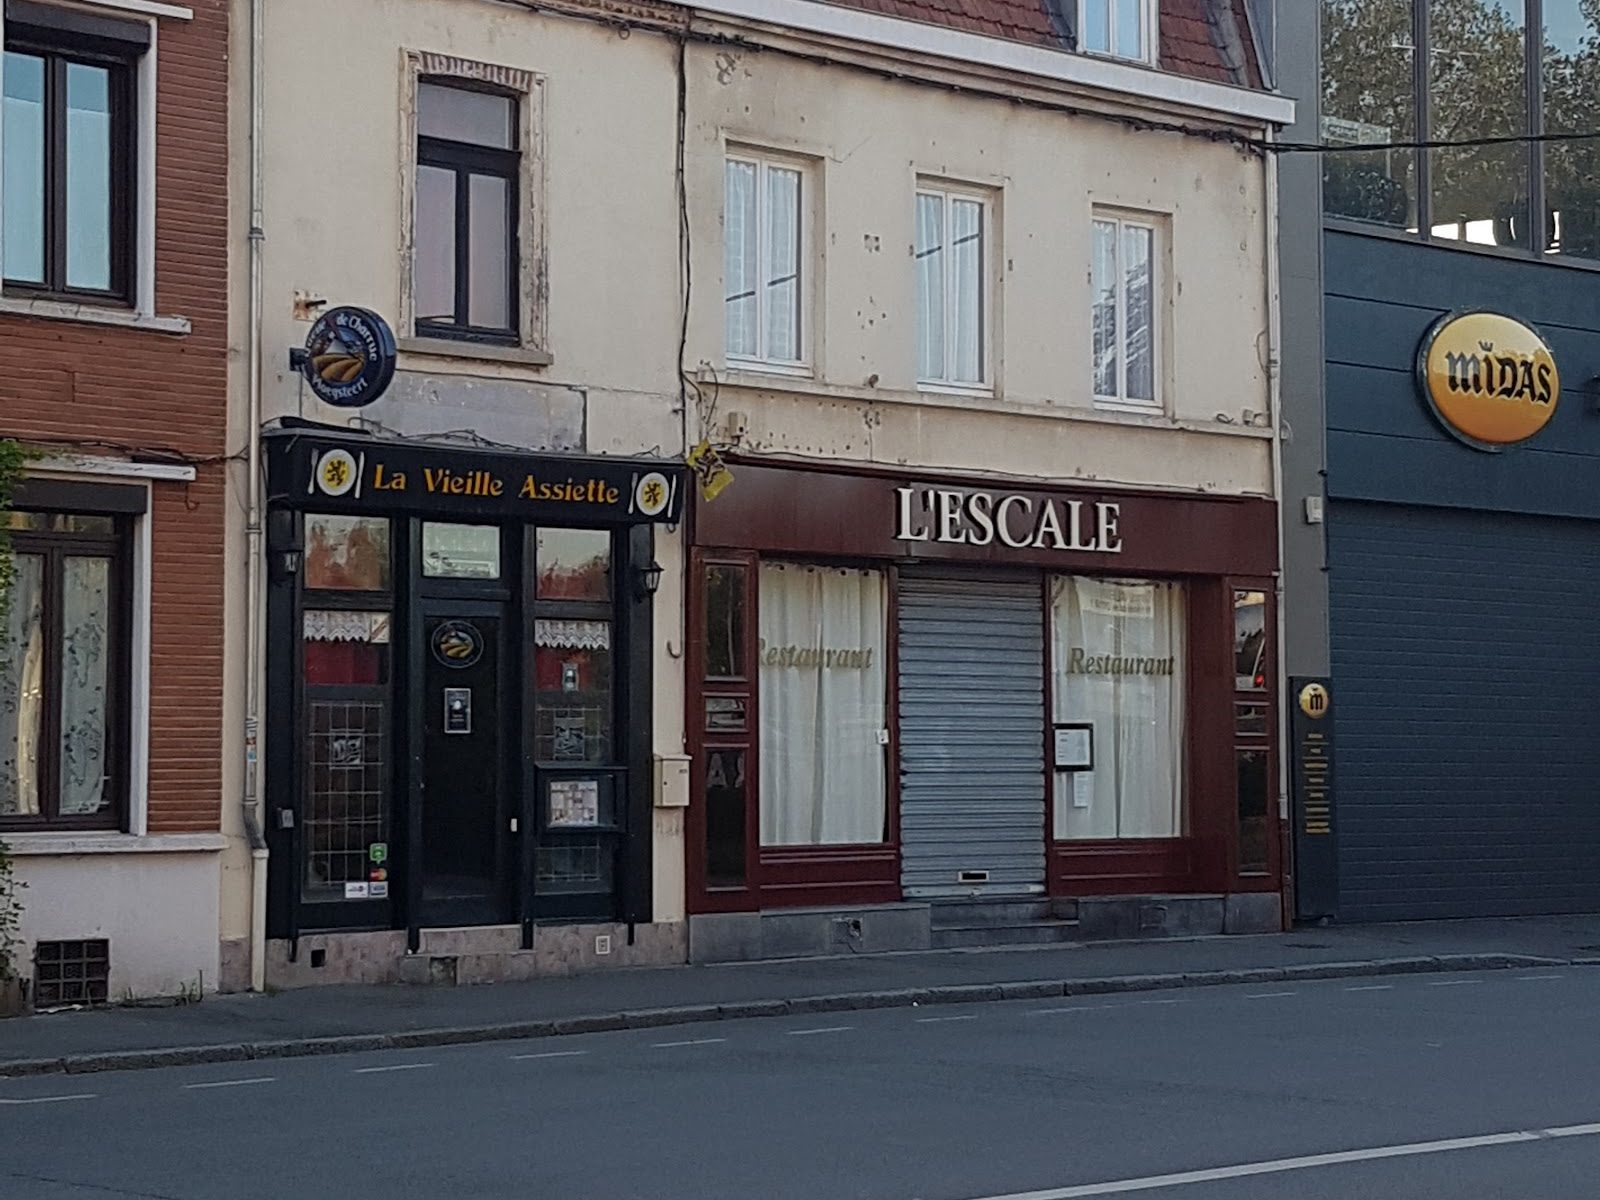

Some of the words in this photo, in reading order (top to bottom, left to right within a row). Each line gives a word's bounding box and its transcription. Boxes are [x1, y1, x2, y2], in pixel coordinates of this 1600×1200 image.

[374, 464, 407, 490] La
[423, 468, 504, 497] Vieille
[518, 474, 620, 504] Assiette
[896, 487, 1123, 553] L'ESCALE
[1066, 646, 1175, 676] Restaurant
